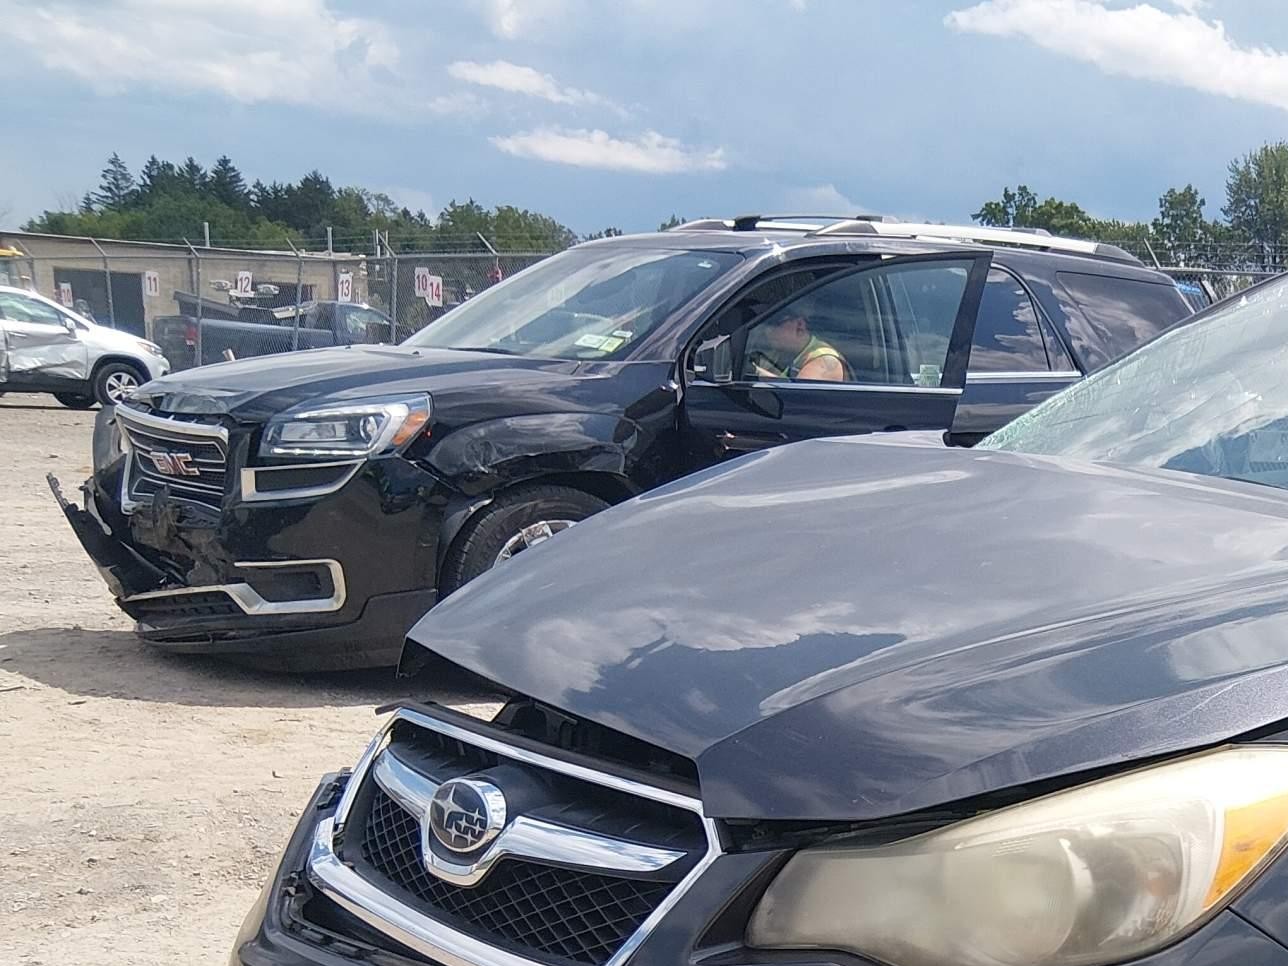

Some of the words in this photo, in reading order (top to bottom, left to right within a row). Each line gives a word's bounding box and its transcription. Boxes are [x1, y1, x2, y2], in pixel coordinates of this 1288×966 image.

[147, 276, 159, 293] 11
[238, 276, 250, 293] 12
[339, 279, 351, 297] 13
[416, 274, 428, 292] 10
[429, 281, 441, 301] 14
[150, 451, 200, 476] GMC
